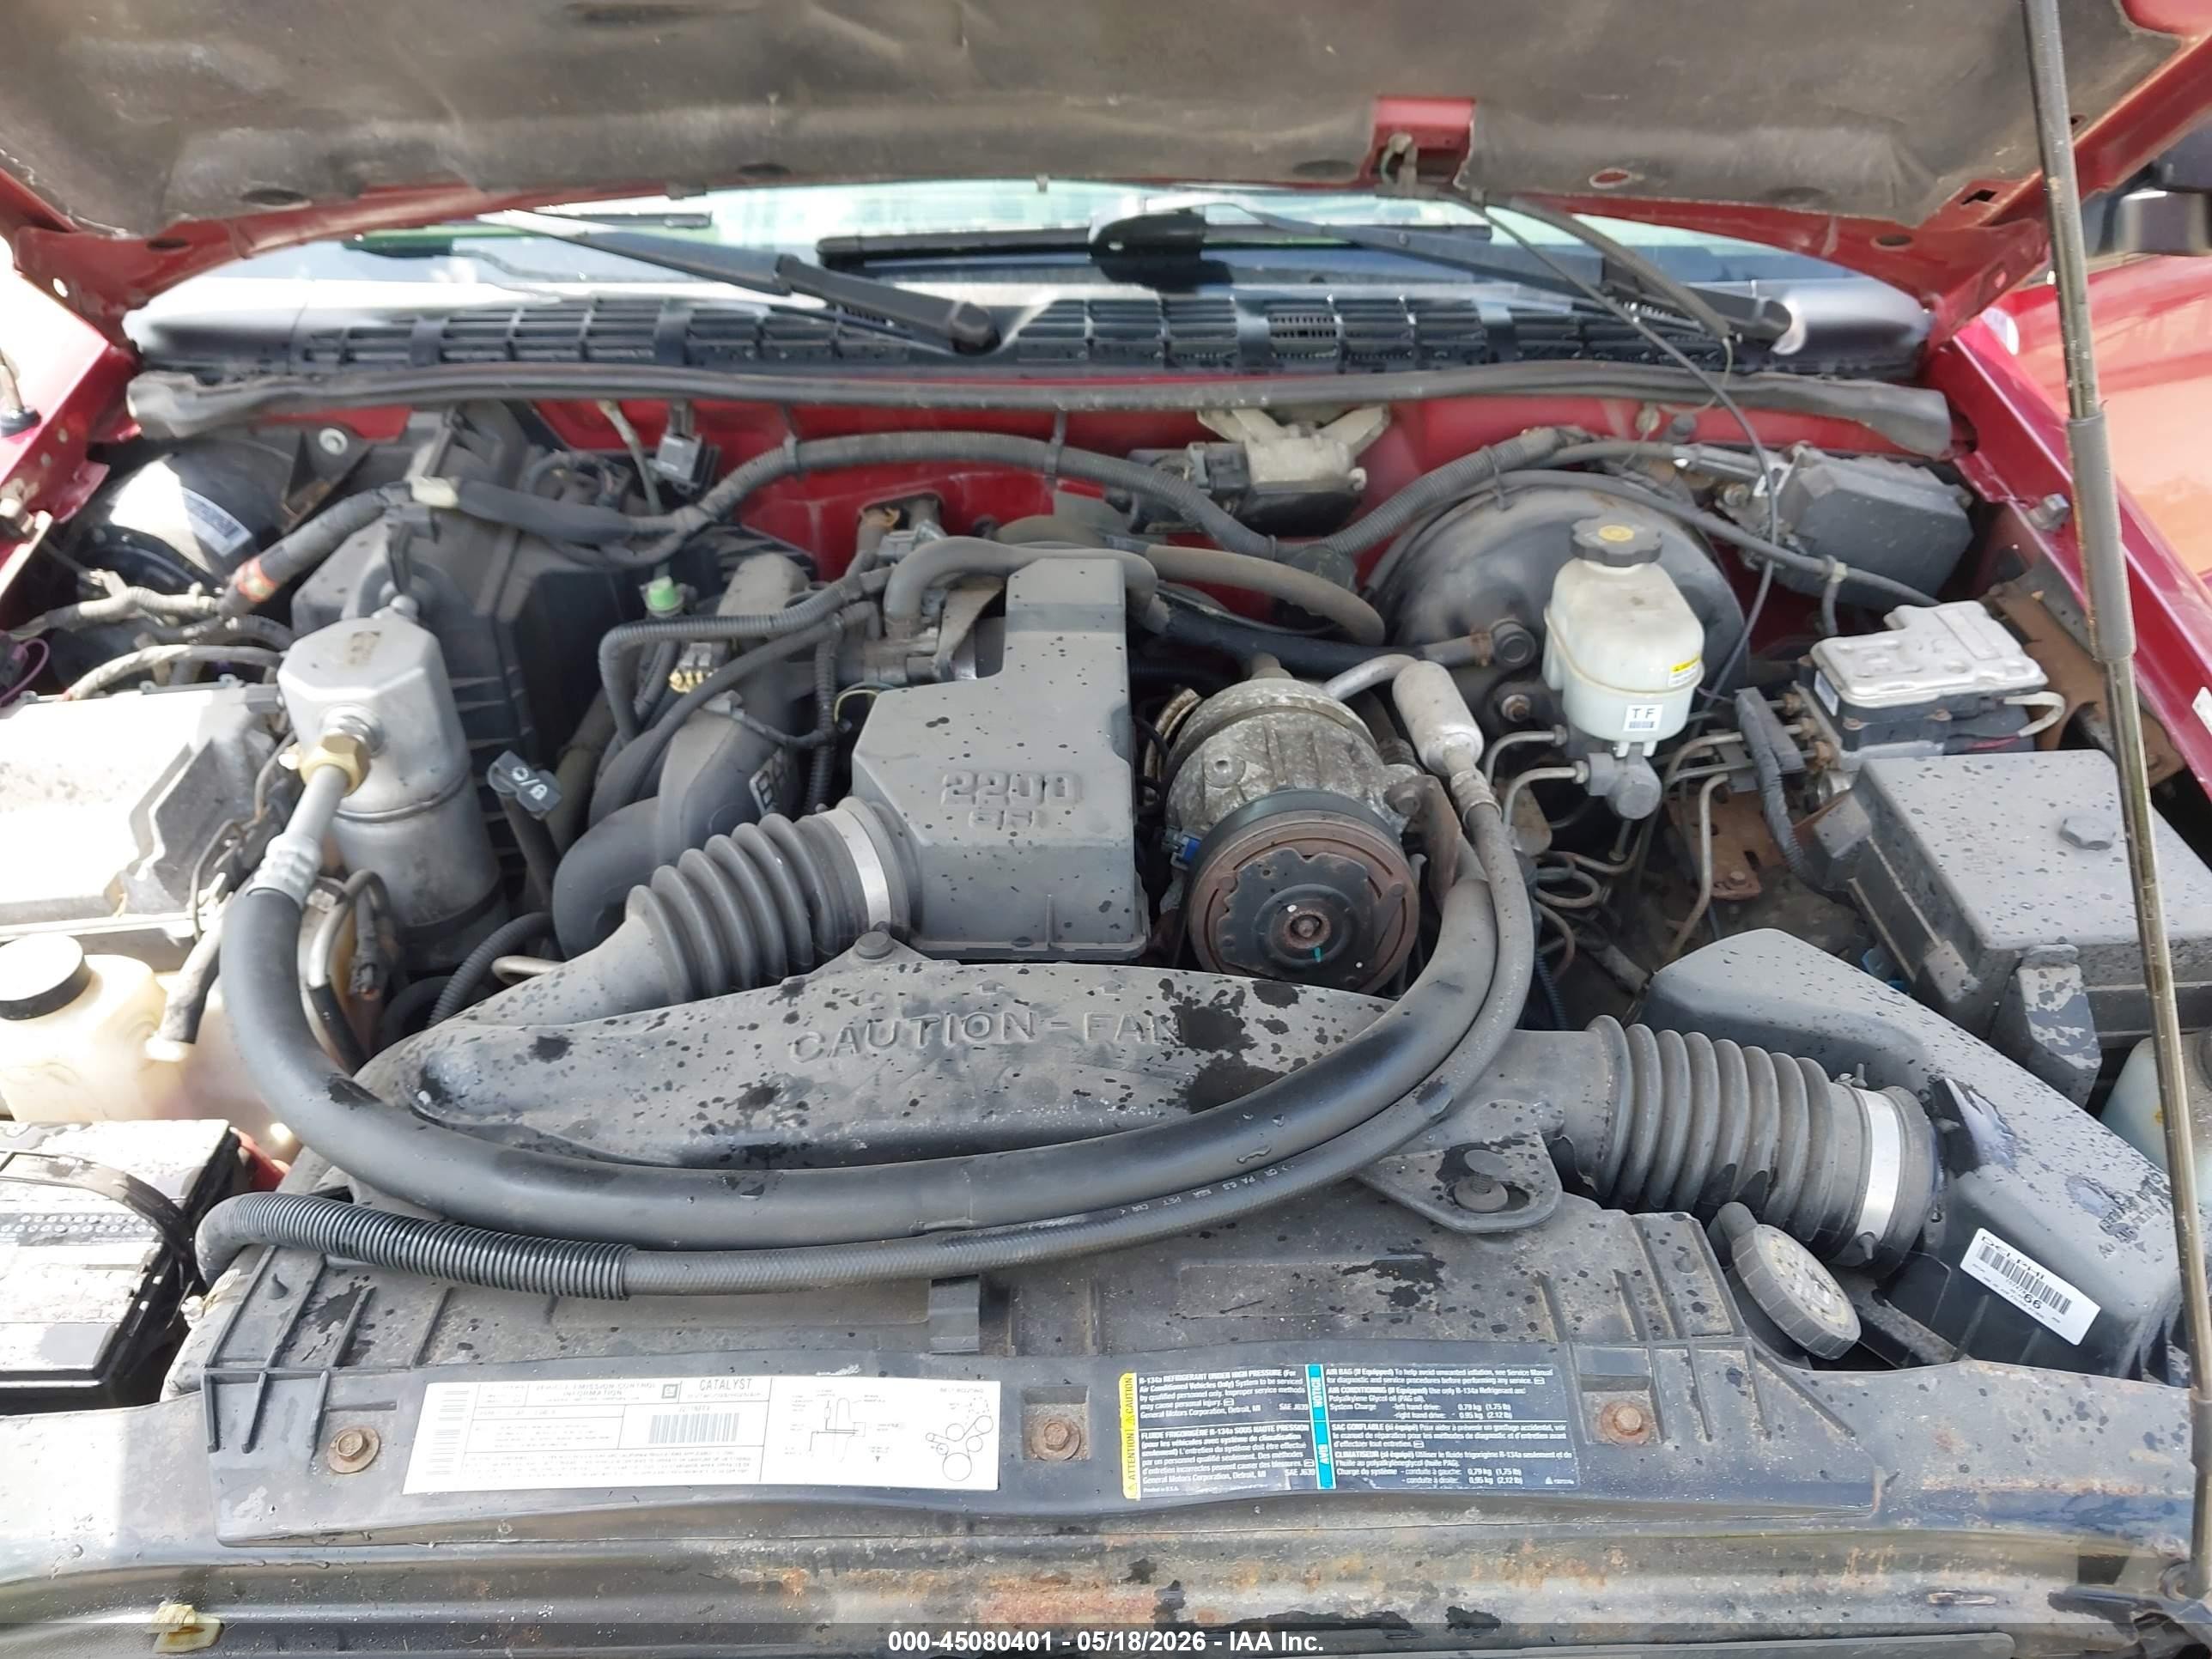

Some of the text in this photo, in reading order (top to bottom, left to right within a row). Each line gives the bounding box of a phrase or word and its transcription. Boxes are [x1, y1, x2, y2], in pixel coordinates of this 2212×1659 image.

[941, 771, 1085, 807] 2200
[789, 1010, 1036, 1063] CAUTION
[2023, 1292, 2044, 1310] 66
[699, 1378, 752, 1391] CATALYST
[1125, 1376, 1133, 1414] CAUTION
[1126, 1431, 1136, 1481] ATTENTION
